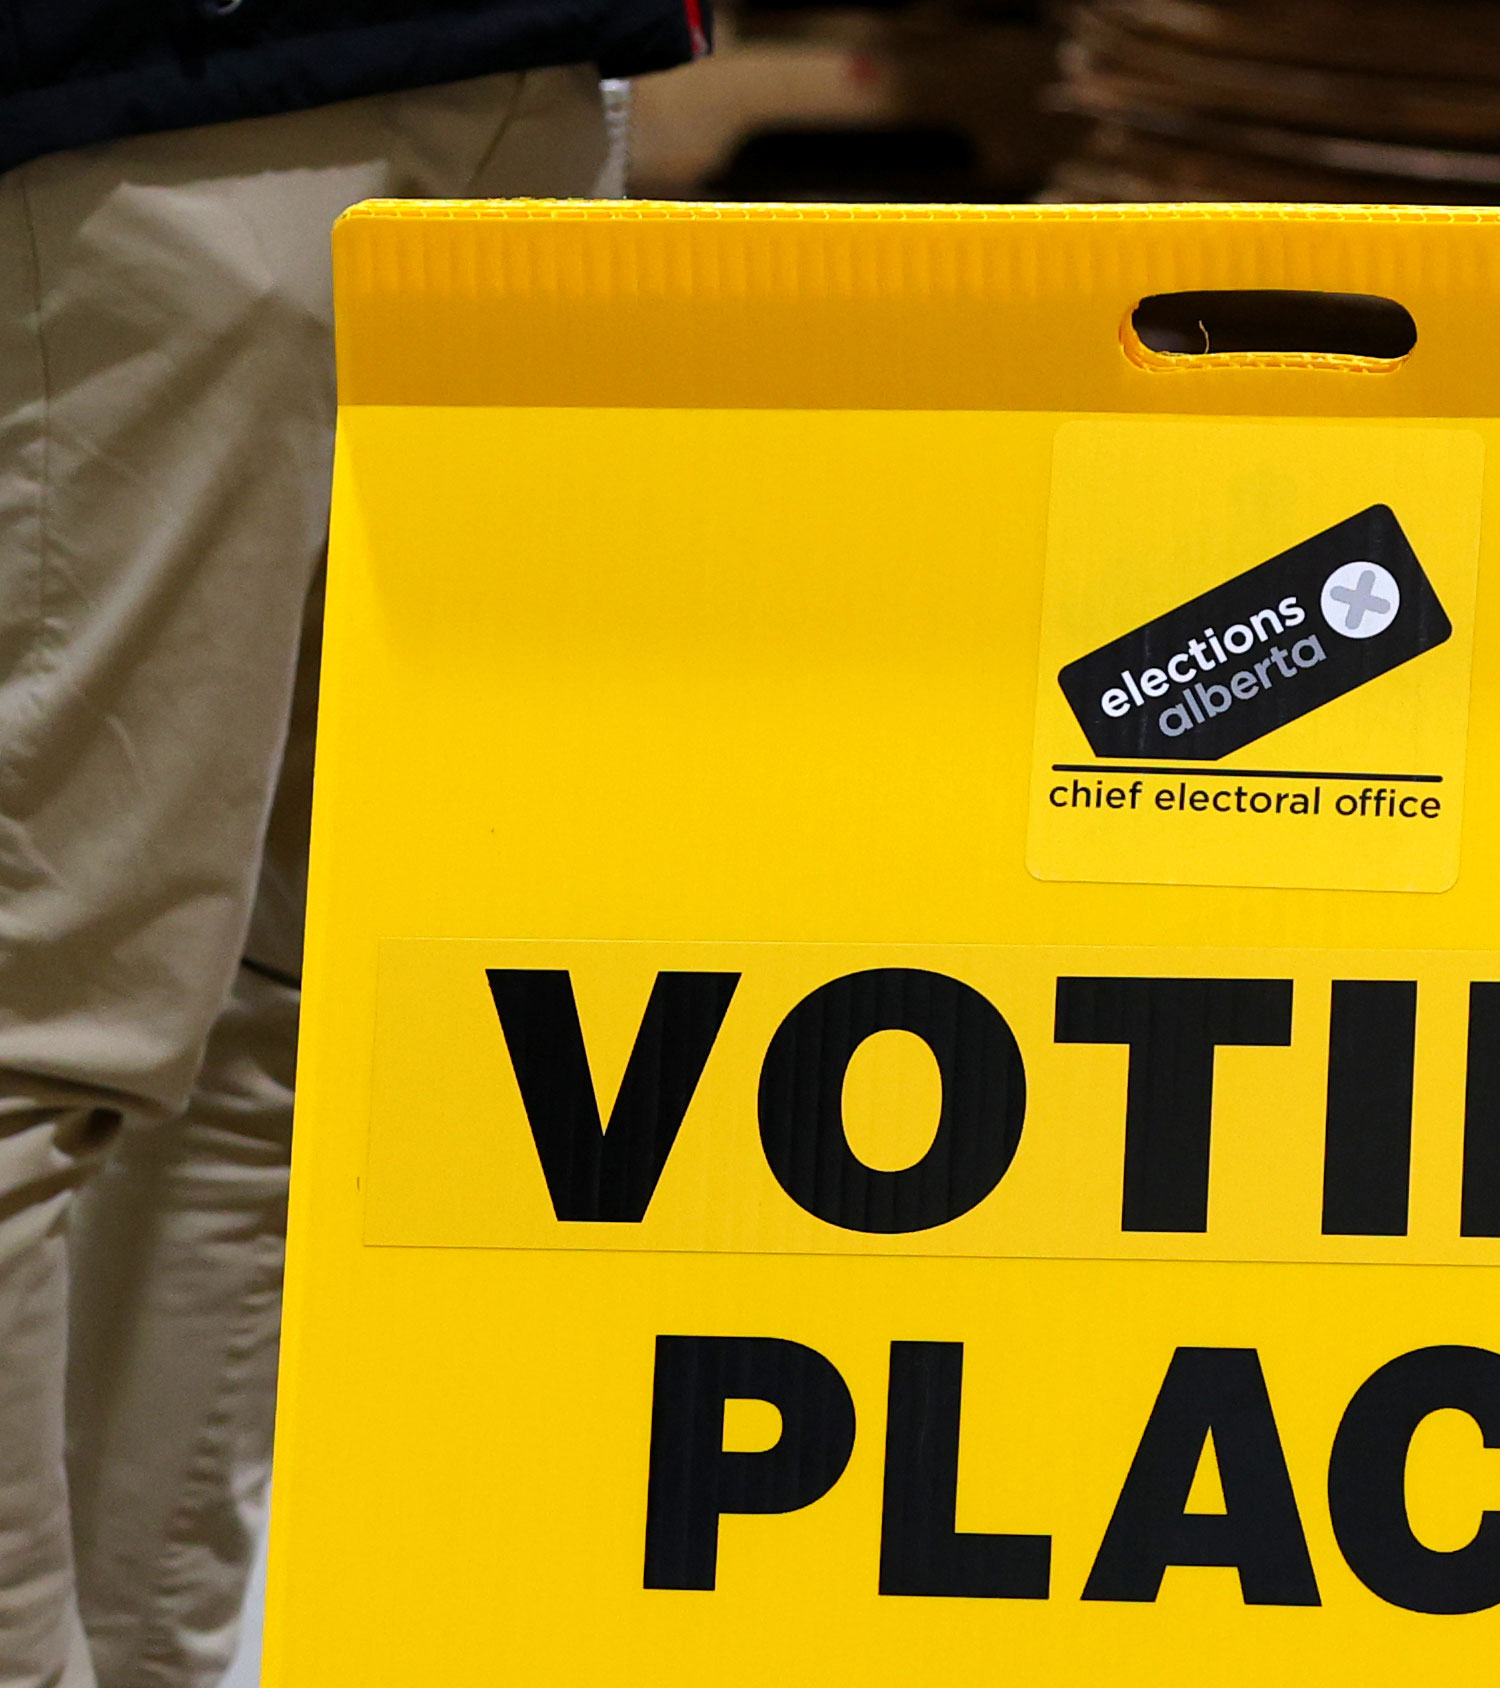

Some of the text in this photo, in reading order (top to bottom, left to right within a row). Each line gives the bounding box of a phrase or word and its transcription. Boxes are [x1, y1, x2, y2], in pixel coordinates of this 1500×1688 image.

[1101, 594, 1306, 718] elections
[1158, 634, 1327, 737] alberta
[1048, 781, 1442, 819] chief electoral office
